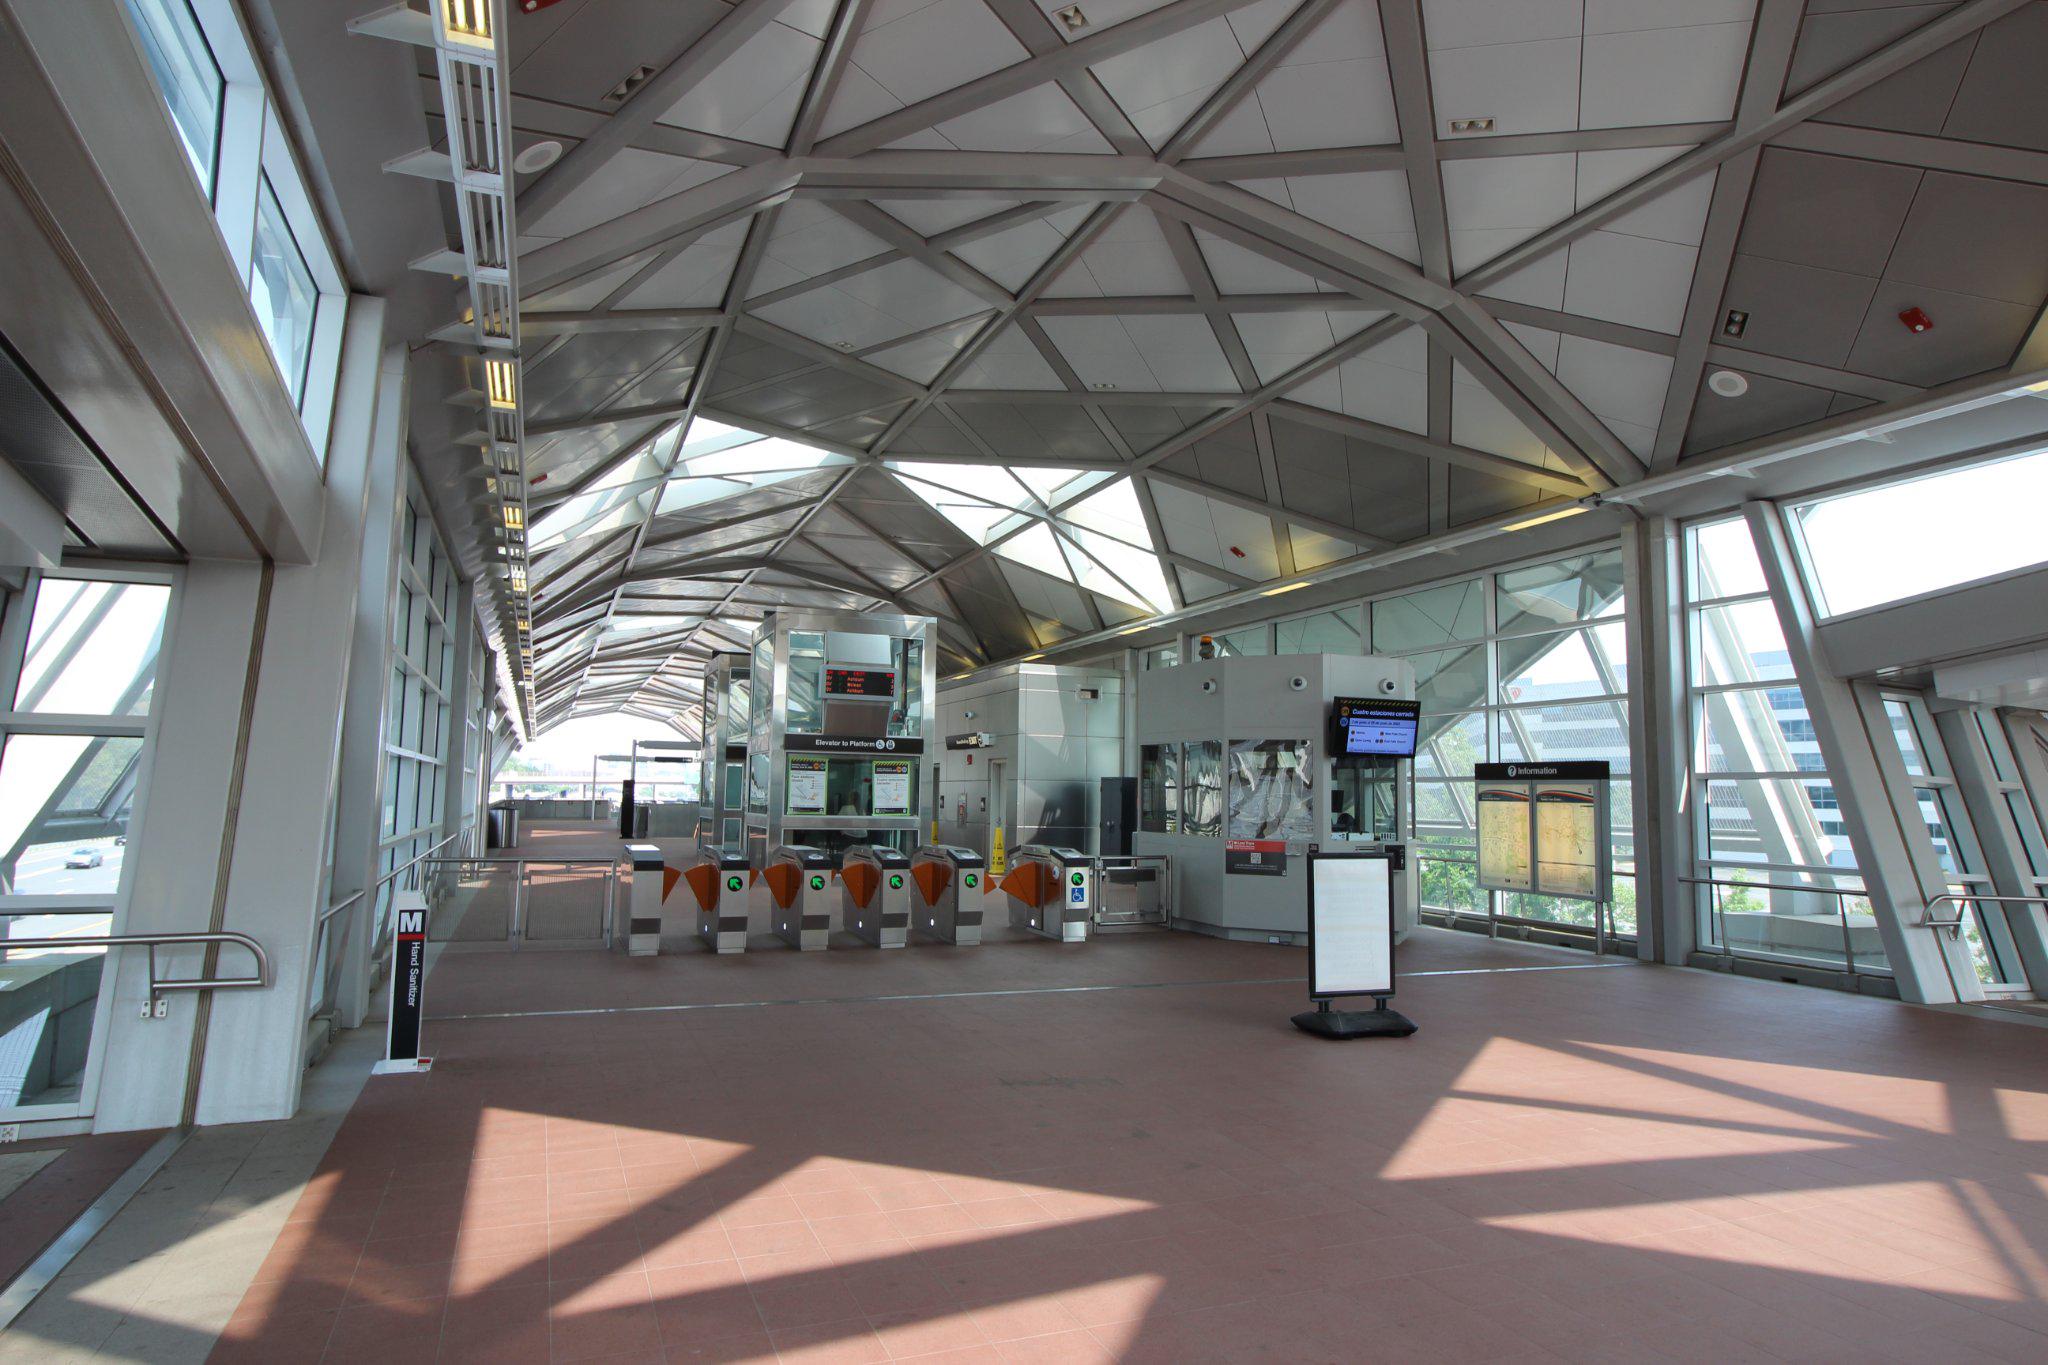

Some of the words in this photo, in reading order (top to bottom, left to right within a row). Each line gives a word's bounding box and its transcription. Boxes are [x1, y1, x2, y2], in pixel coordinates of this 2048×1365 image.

[849, 740, 876, 748] Platform
[1518, 766, 1558, 776] Information
[400, 911, 422, 933] M
[410, 941, 421, 966] Hand
[407, 968, 420, 1007] Sanitizer
